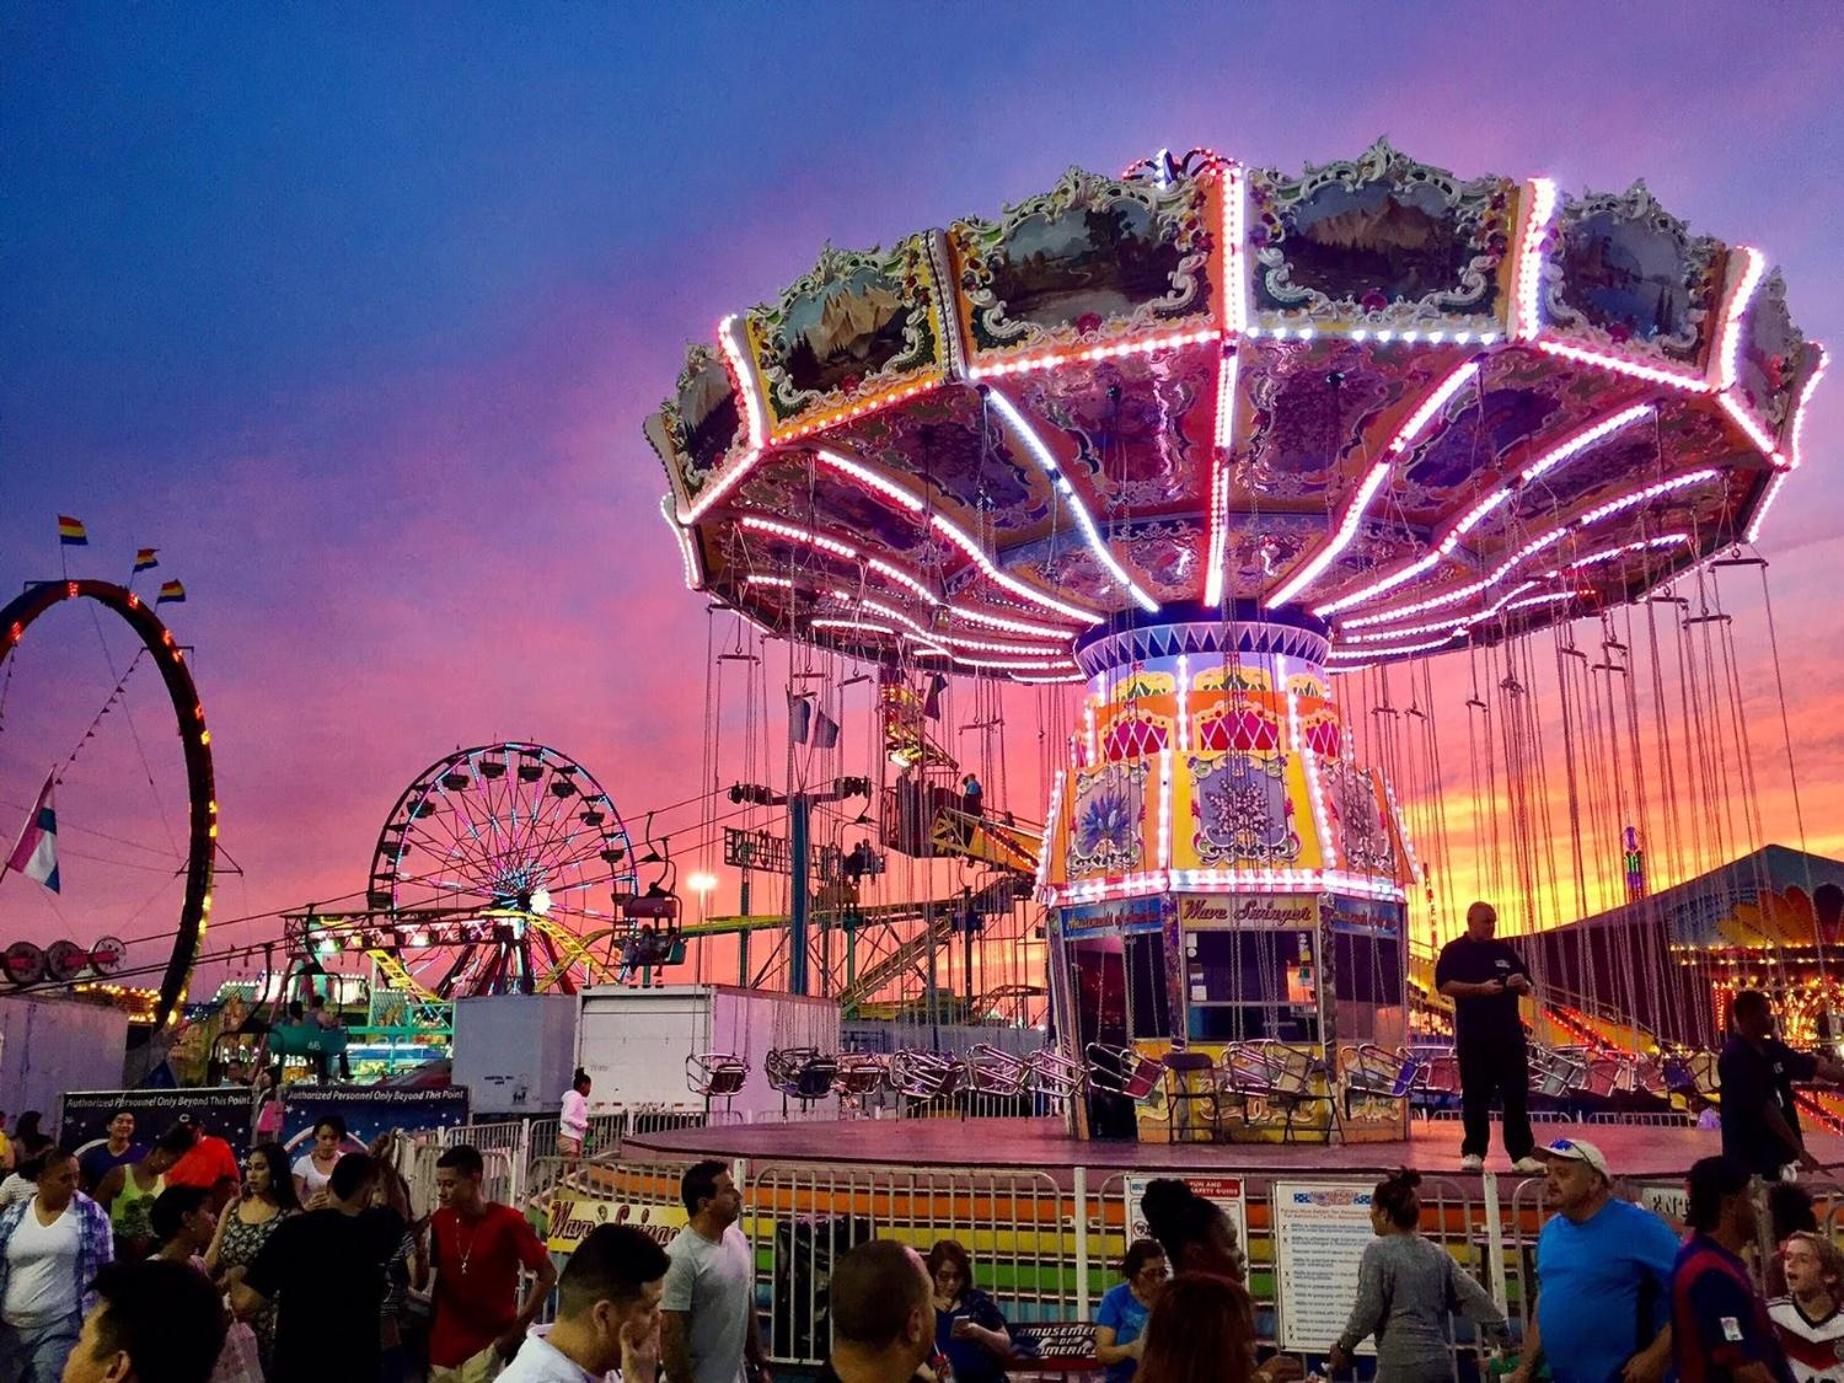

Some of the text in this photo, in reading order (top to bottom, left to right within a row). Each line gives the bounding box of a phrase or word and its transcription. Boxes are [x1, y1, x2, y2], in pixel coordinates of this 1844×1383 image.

[1183, 899, 1228, 920] Wave
[1234, 901, 1312, 926] Swinger
[67, 1094, 250, 1108] Authorized Personnel Only Beyond This Point
[288, 1087, 464, 1102] Authorized Personnel Only Beyond This Point
